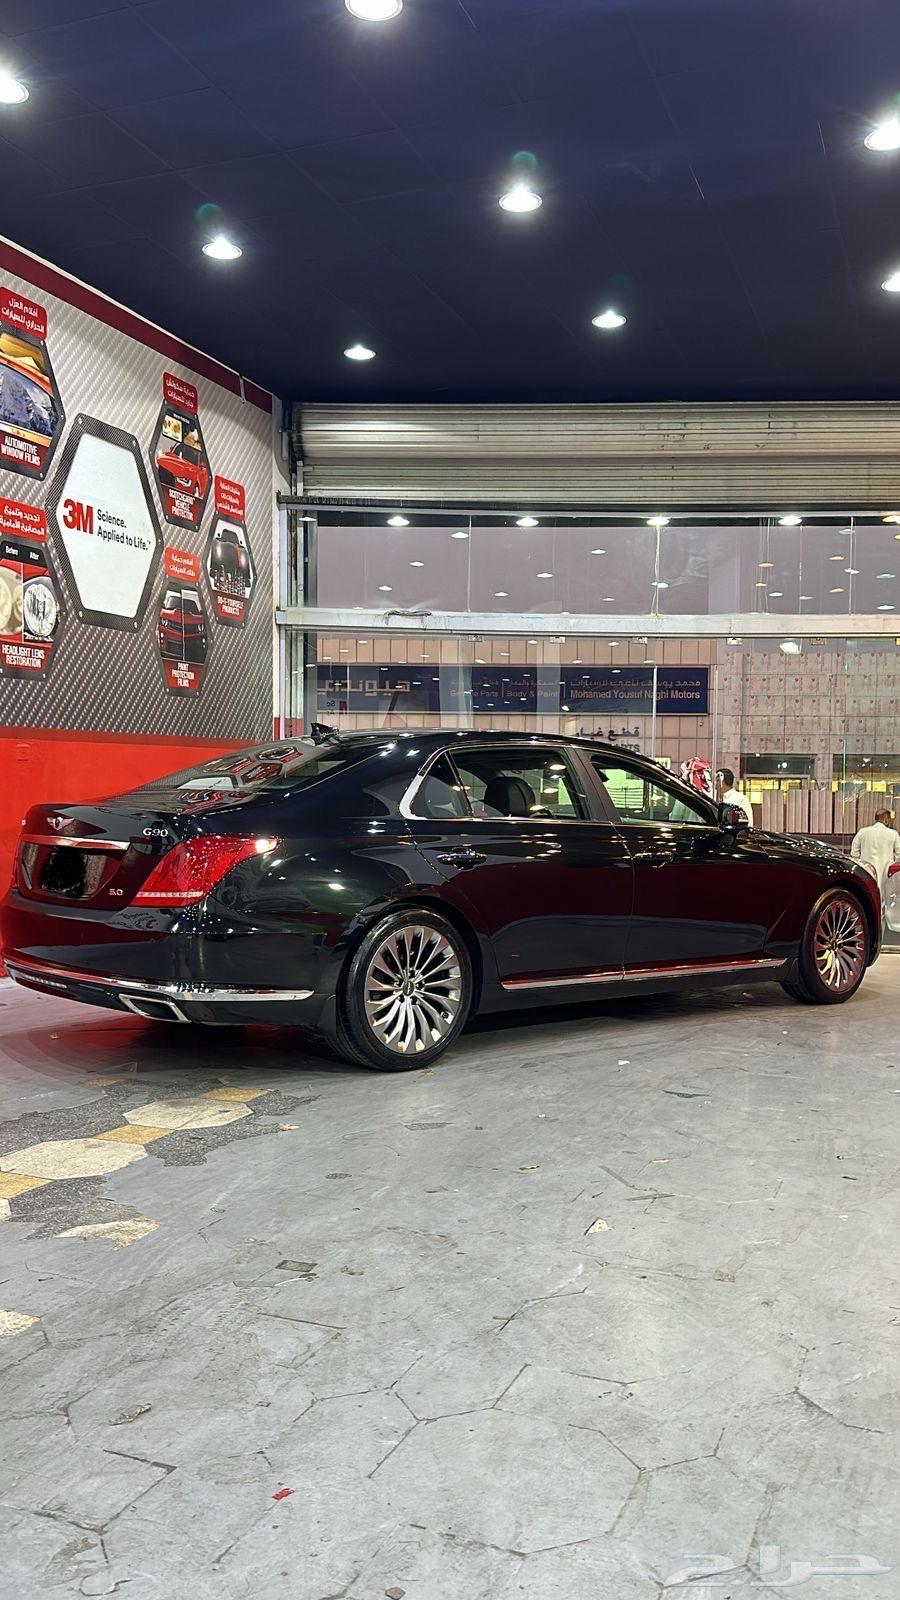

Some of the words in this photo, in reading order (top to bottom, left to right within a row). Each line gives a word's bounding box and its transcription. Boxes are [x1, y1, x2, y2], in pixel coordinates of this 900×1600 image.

[4, 435, 38, 456] AUTOMOTIVE
[24, 452, 41, 467] FILMS
[63, 498, 94, 535] 3M
[97, 508, 127, 529] Science.
[97, 525, 125, 544] Applied
[125, 534, 133, 546] to
[2, 644, 31, 657] HEADLIGHT
[31, 648, 45, 660] LENS
[5, 654, 42, 668] RESTORATION
[480, 690, 499, 698] Parts
[506, 690, 528, 699] Body
[537, 690, 559, 698] Paint
[671, 689, 701, 699] Motors
[607, 726, 640, 741] قطع
[143, 828, 169, 837] G90
[109, 888, 123, 896] 5.0
